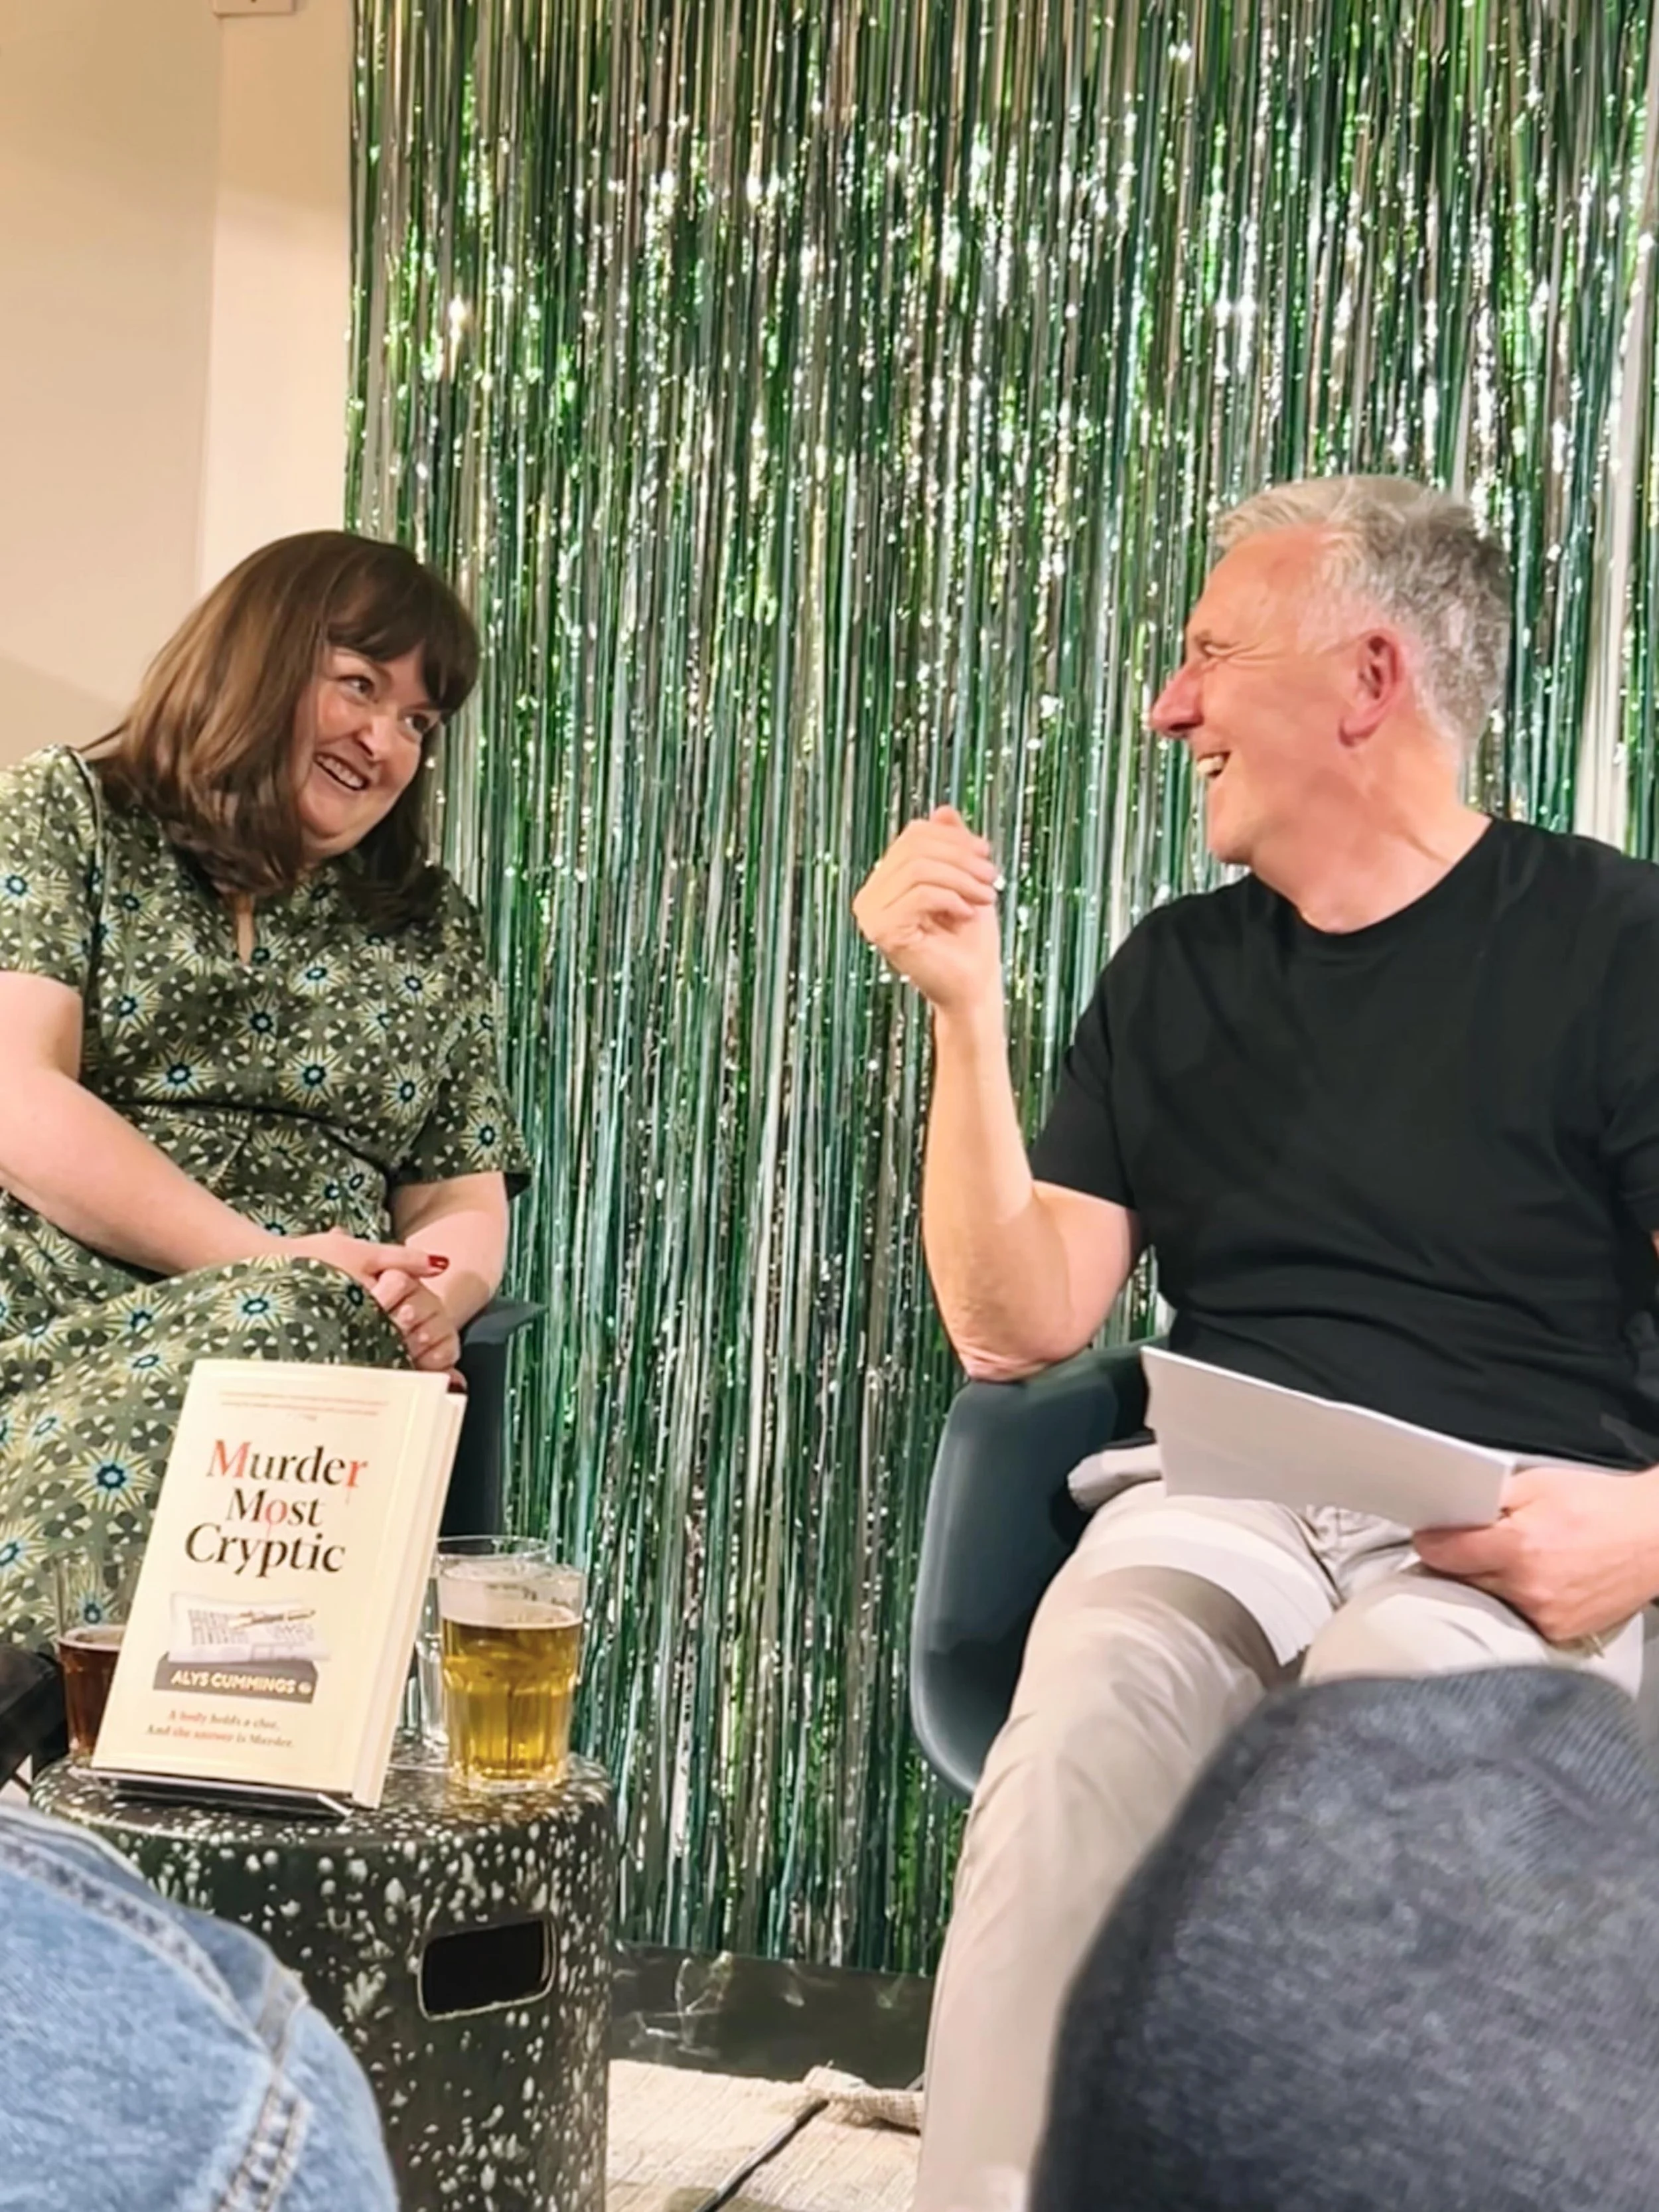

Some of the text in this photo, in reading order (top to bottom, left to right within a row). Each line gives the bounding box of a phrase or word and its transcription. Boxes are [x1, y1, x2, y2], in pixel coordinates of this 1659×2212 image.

[206, 1439, 368, 1487] Murder
[225, 1487, 325, 1527] Most
[185, 1522, 346, 1579] Cryptic
[171, 1669, 297, 1694] ALYS CUMMINGS
